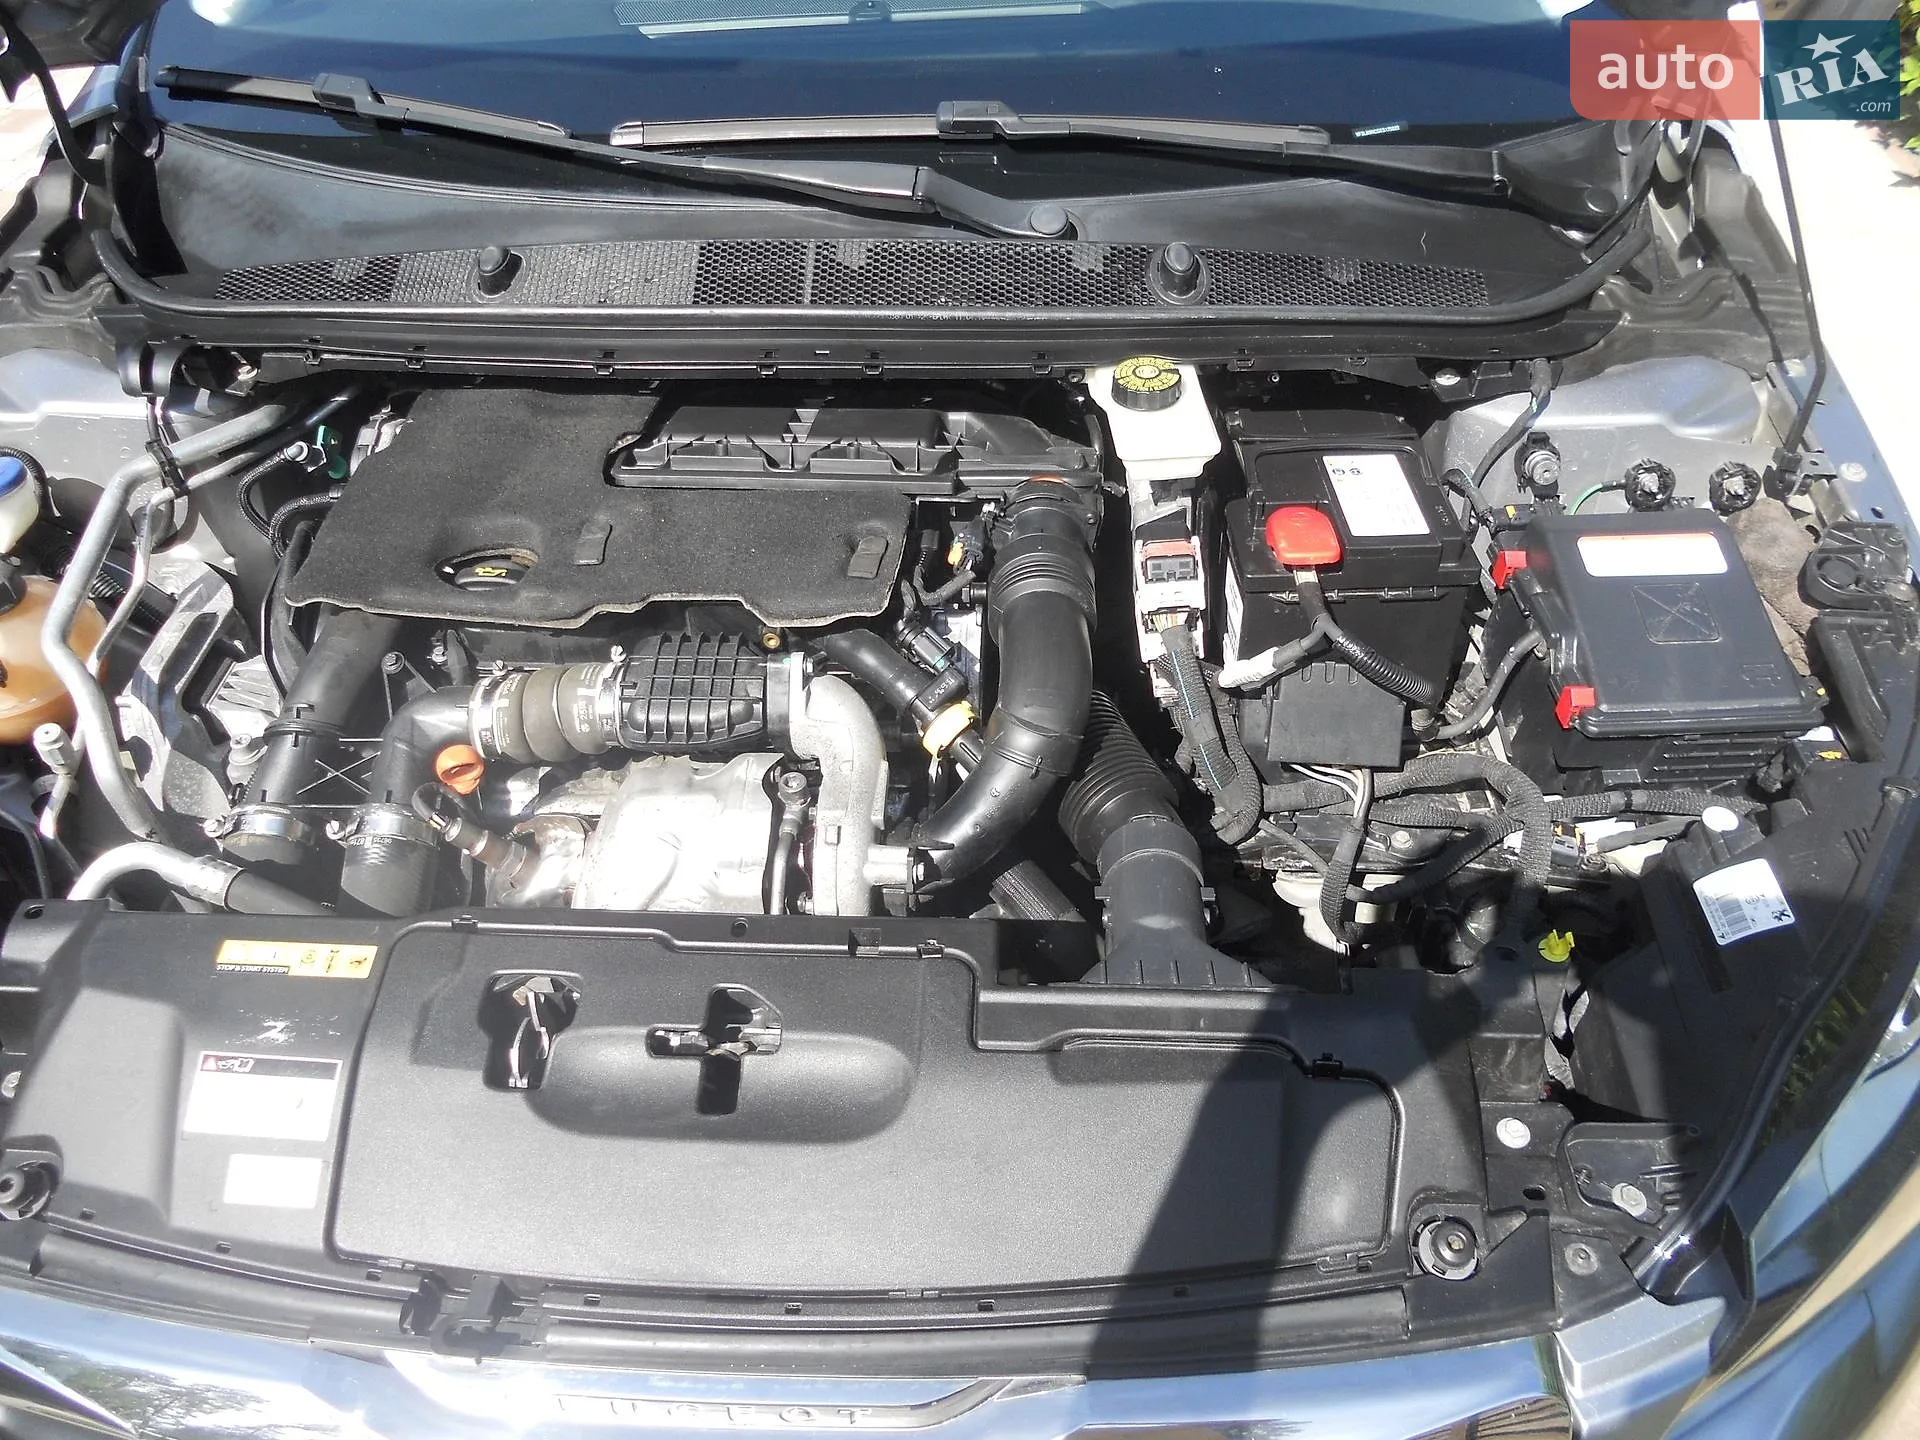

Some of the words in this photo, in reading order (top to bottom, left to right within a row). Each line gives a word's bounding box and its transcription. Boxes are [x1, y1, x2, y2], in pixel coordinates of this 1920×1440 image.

[216, 964, 235, 972] STOP
[240, 965, 262, 974] START
[554, 1396, 873, 1425] UGEOT
